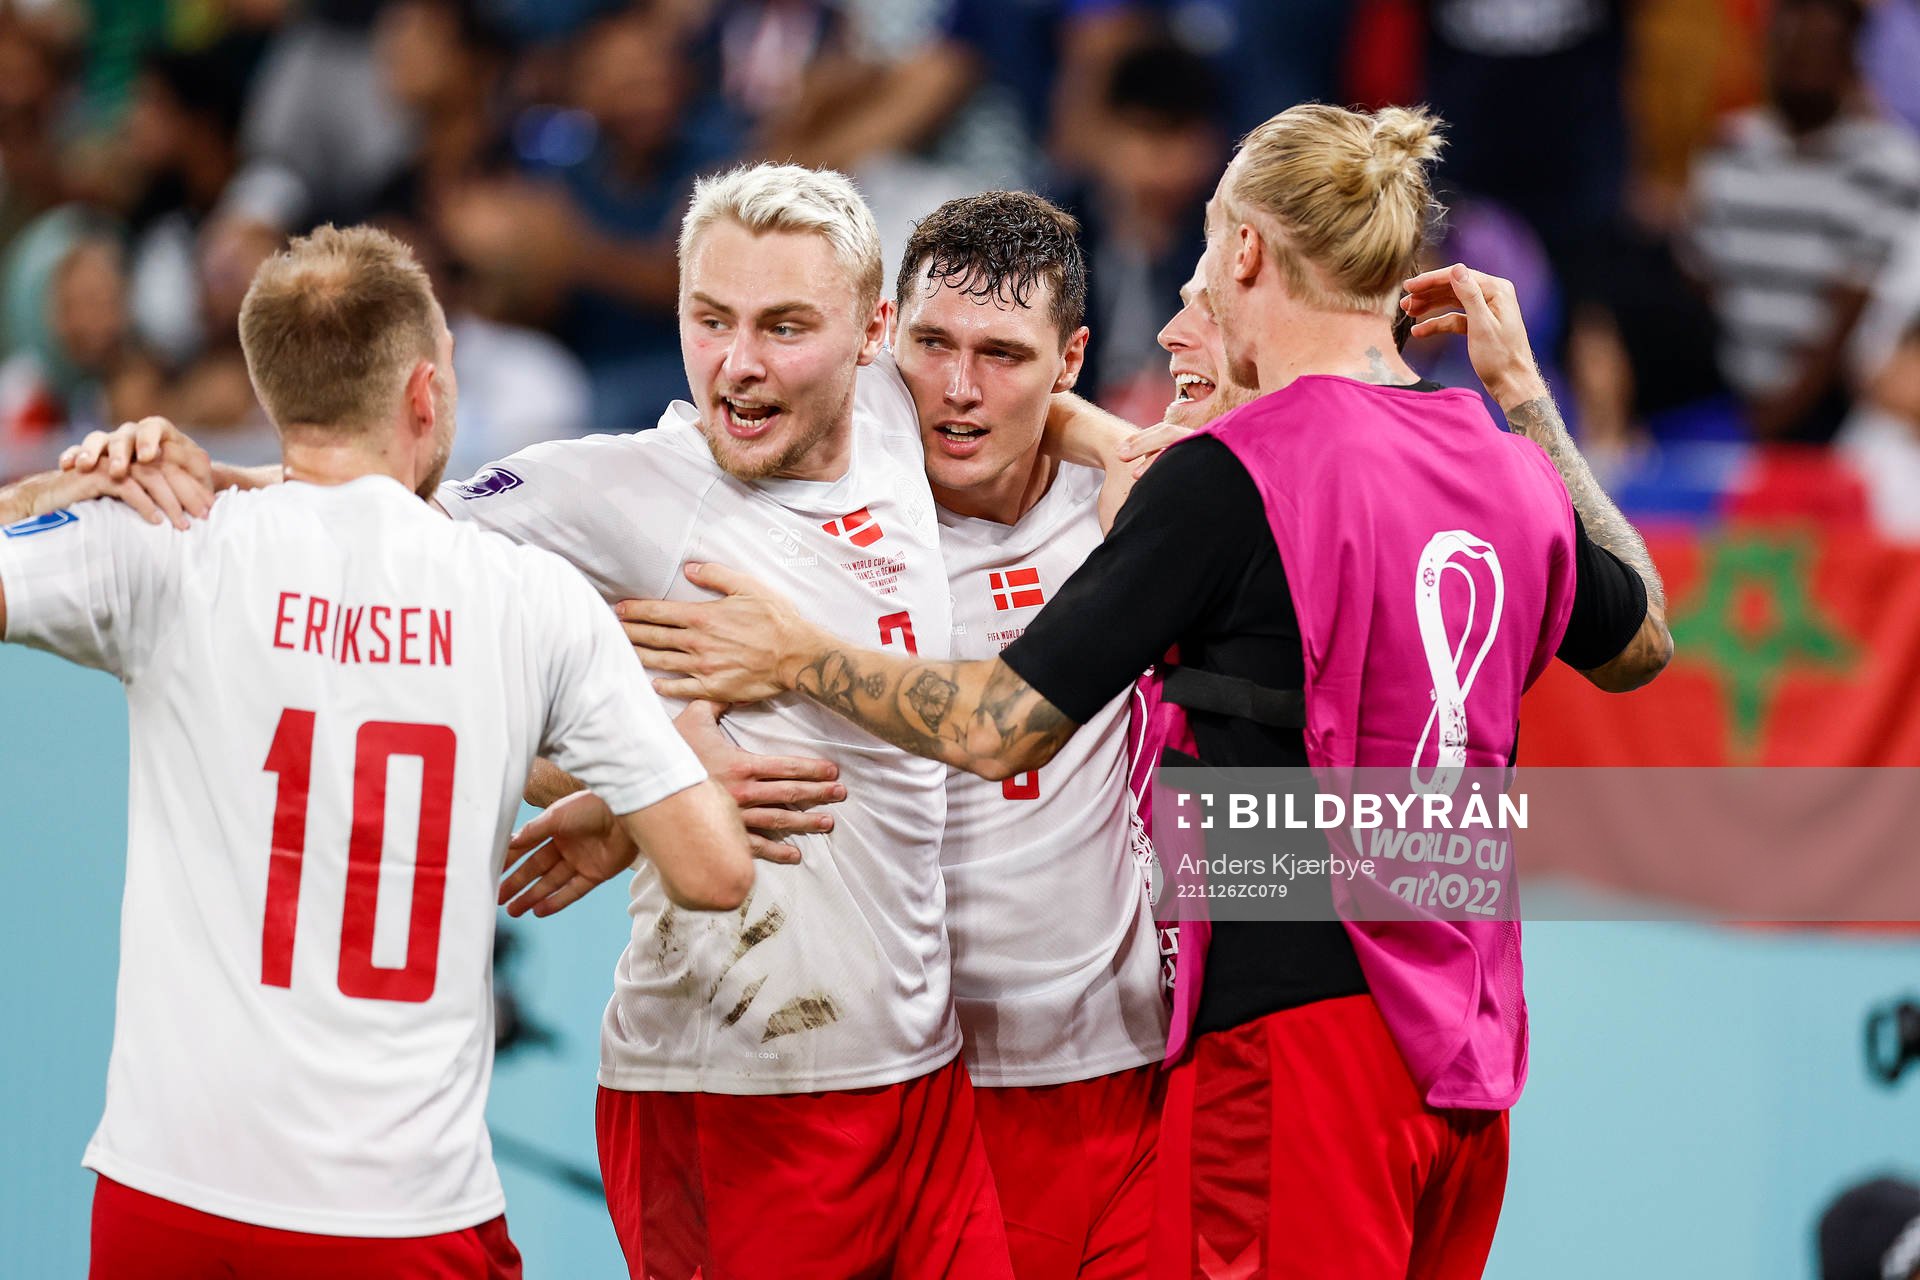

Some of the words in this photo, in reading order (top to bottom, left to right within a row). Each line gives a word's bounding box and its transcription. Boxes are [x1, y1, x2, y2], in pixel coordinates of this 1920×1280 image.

[852, 559, 872, 571] WORLD
[873, 556, 886, 567] CUP
[881, 562, 906, 575] DENMARK
[273, 591, 453, 667] ERIKSEN
[261, 707, 457, 1003] 10
[1369, 828, 1472, 865] WORLD
[1475, 838, 1507, 872] CU
